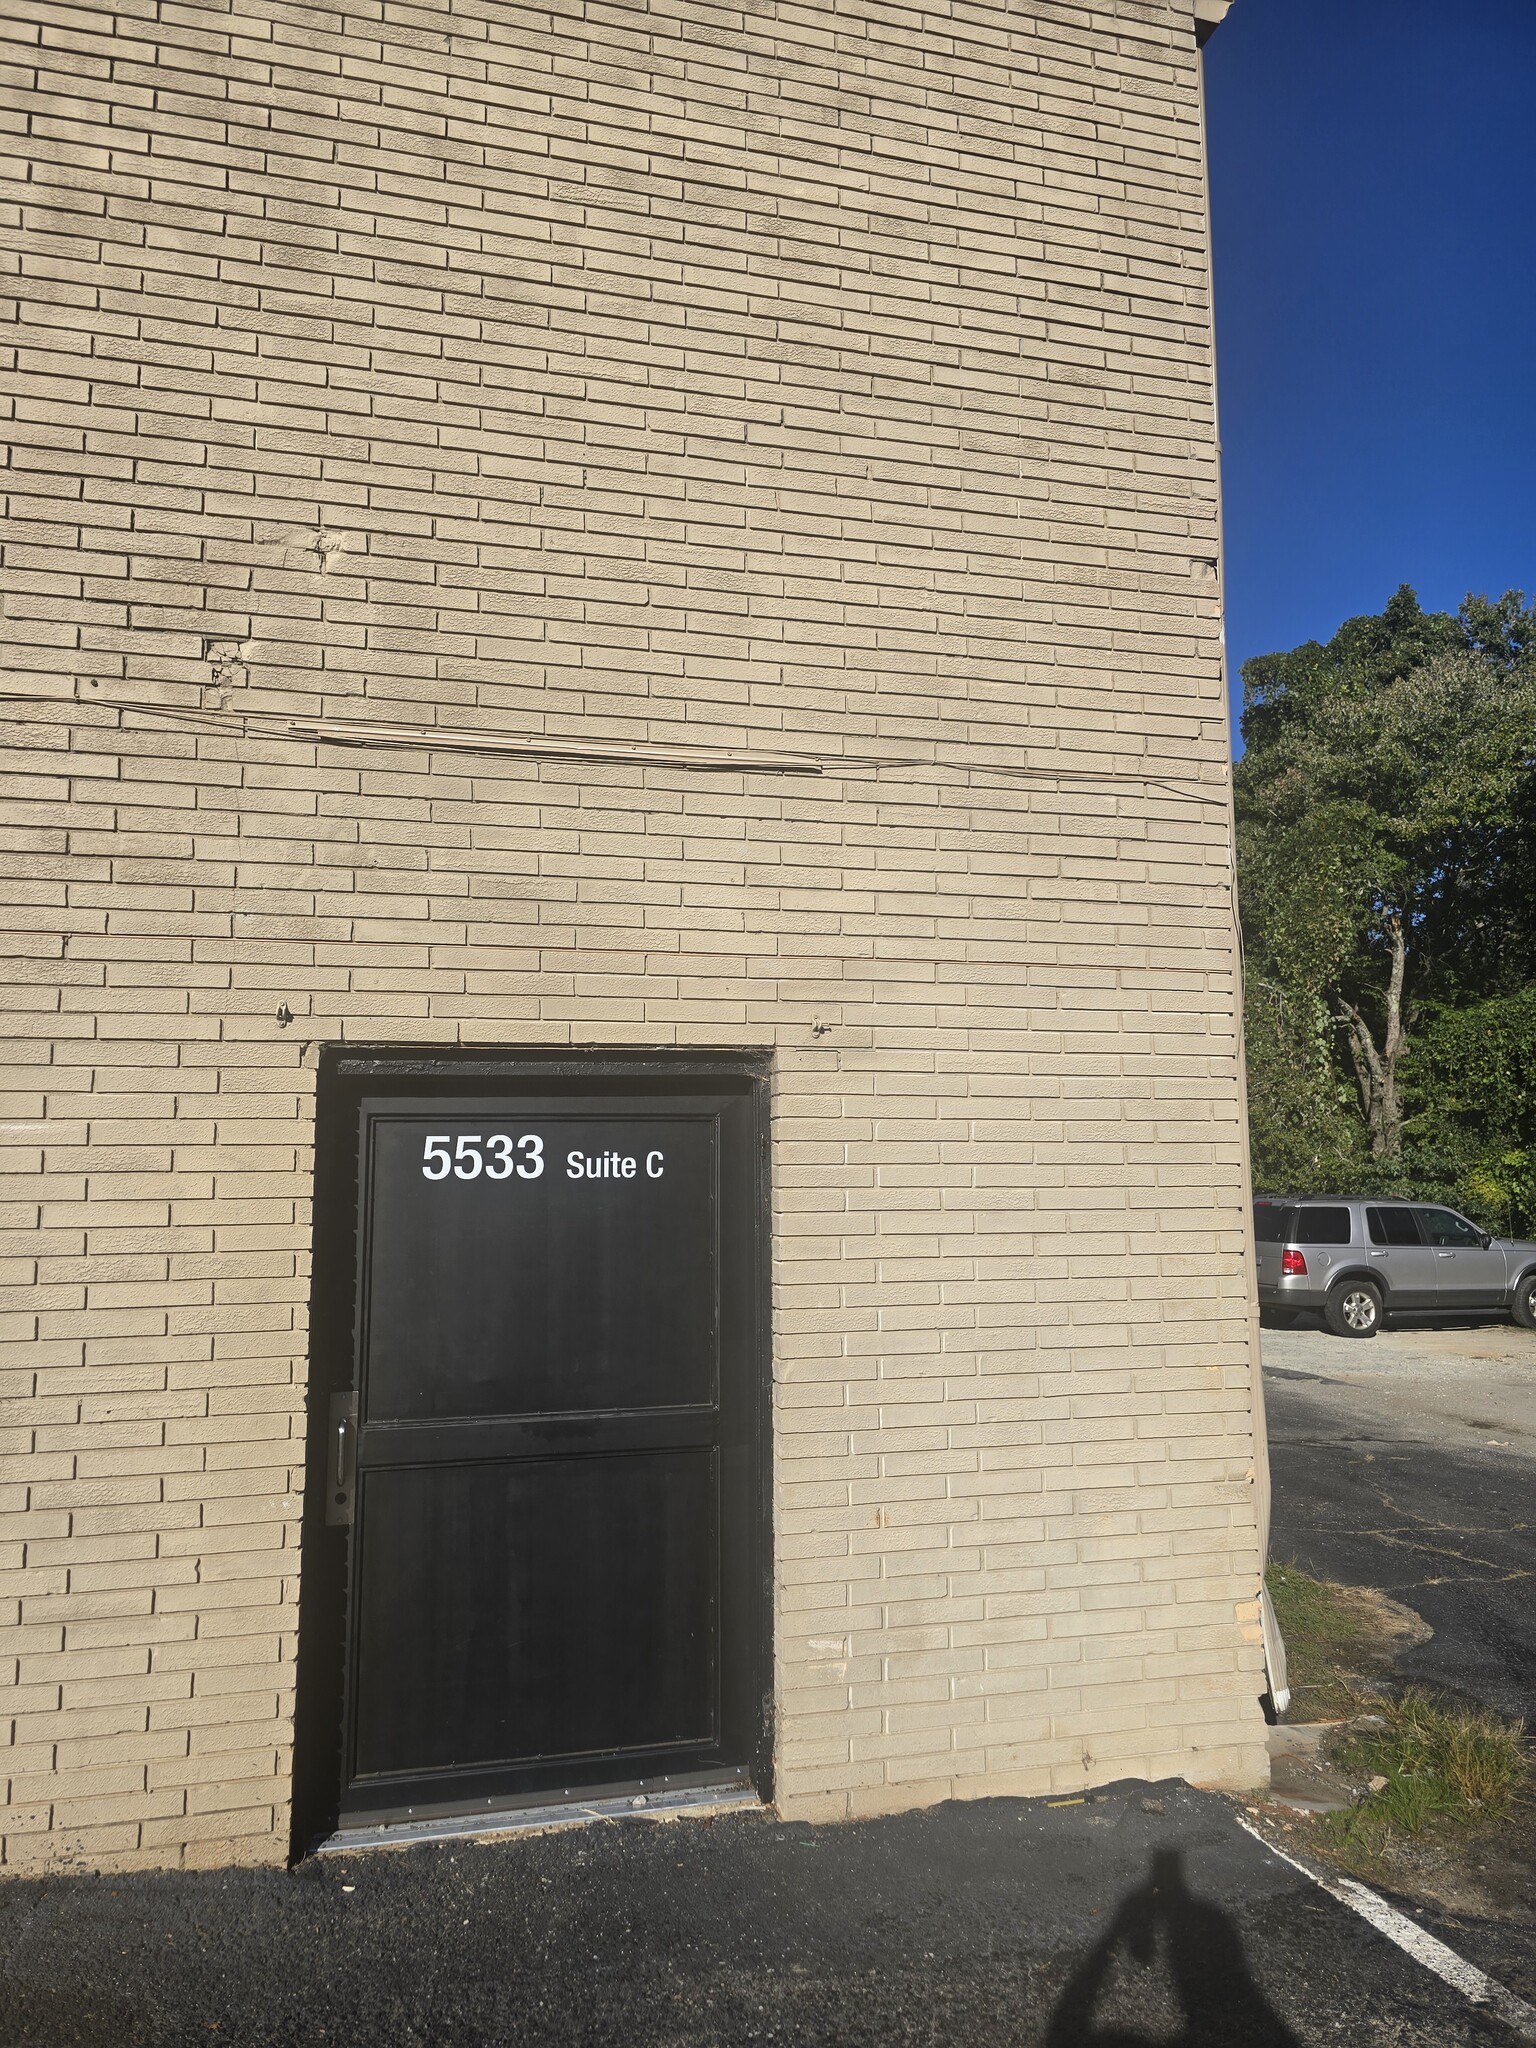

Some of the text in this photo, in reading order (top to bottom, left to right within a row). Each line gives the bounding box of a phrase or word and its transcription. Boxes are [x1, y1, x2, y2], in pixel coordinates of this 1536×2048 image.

[422, 1134, 665, 1181] 5533 Suite C
